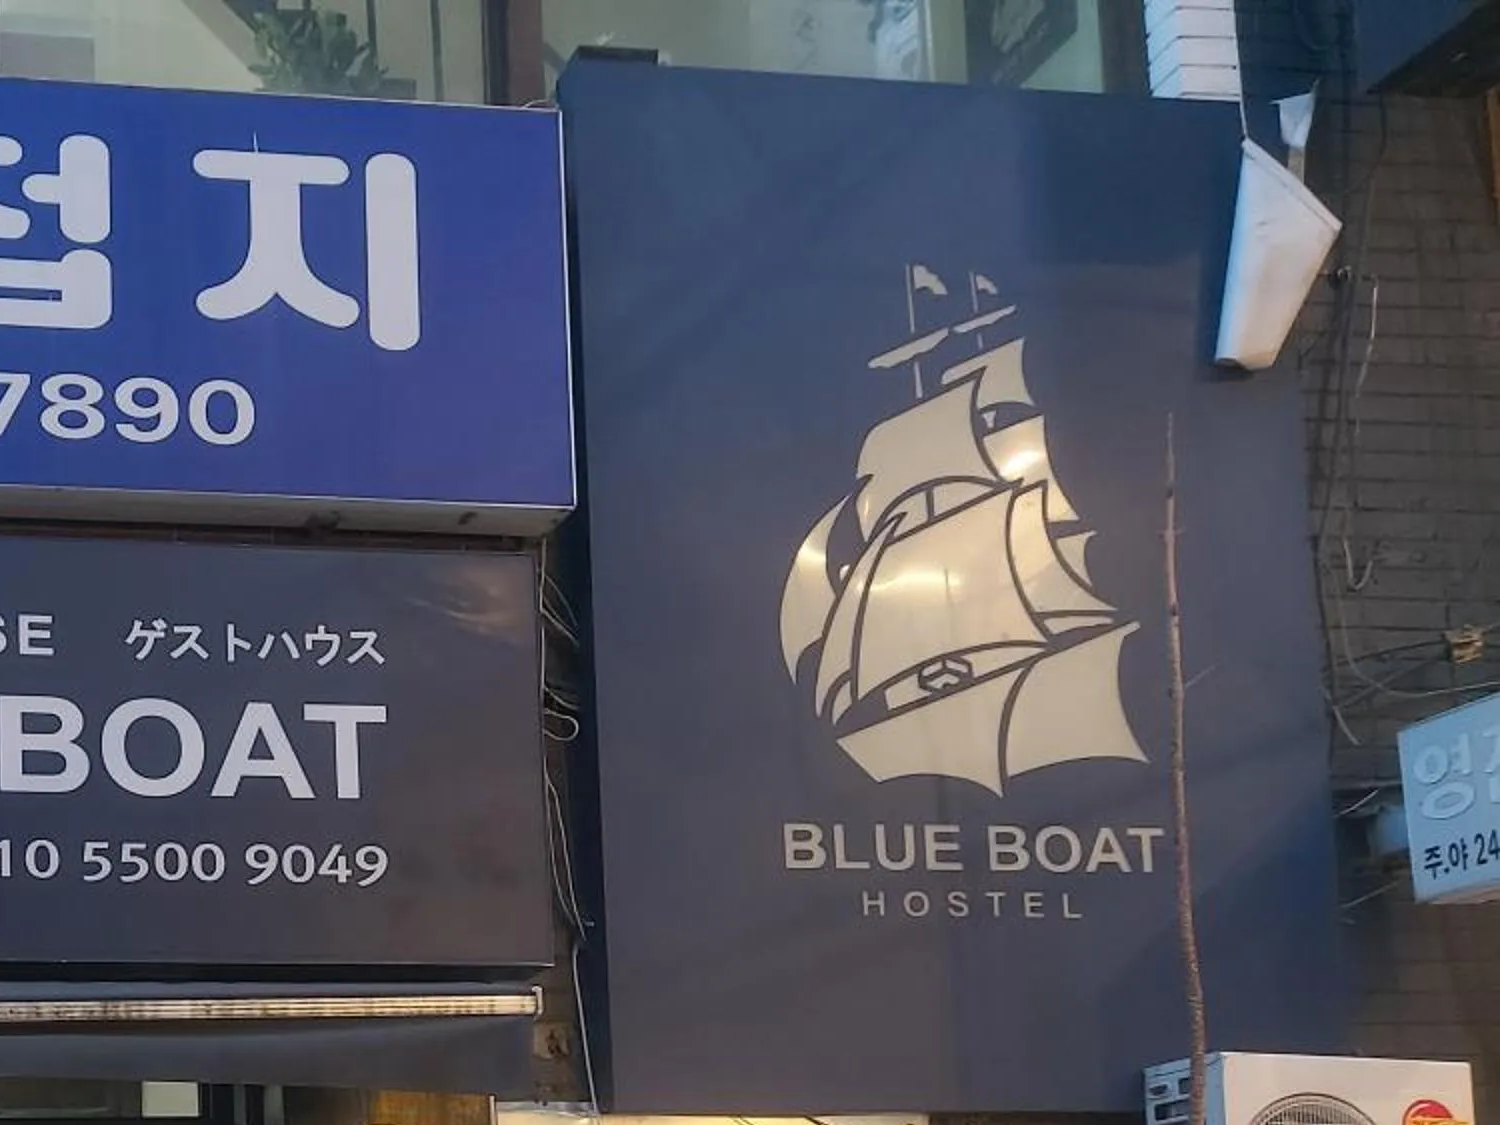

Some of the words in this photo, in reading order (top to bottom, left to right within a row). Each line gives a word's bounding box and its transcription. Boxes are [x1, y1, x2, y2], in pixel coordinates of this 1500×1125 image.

[124, 617, 387, 667] ゲストハウス
[82, 837, 226, 883] 5500
[245, 843, 390, 887] 9049
[783, 823, 964, 872] BLUE
[988, 825, 1166, 874] BOAT
[861, 891, 1083, 919] HOSTEL
